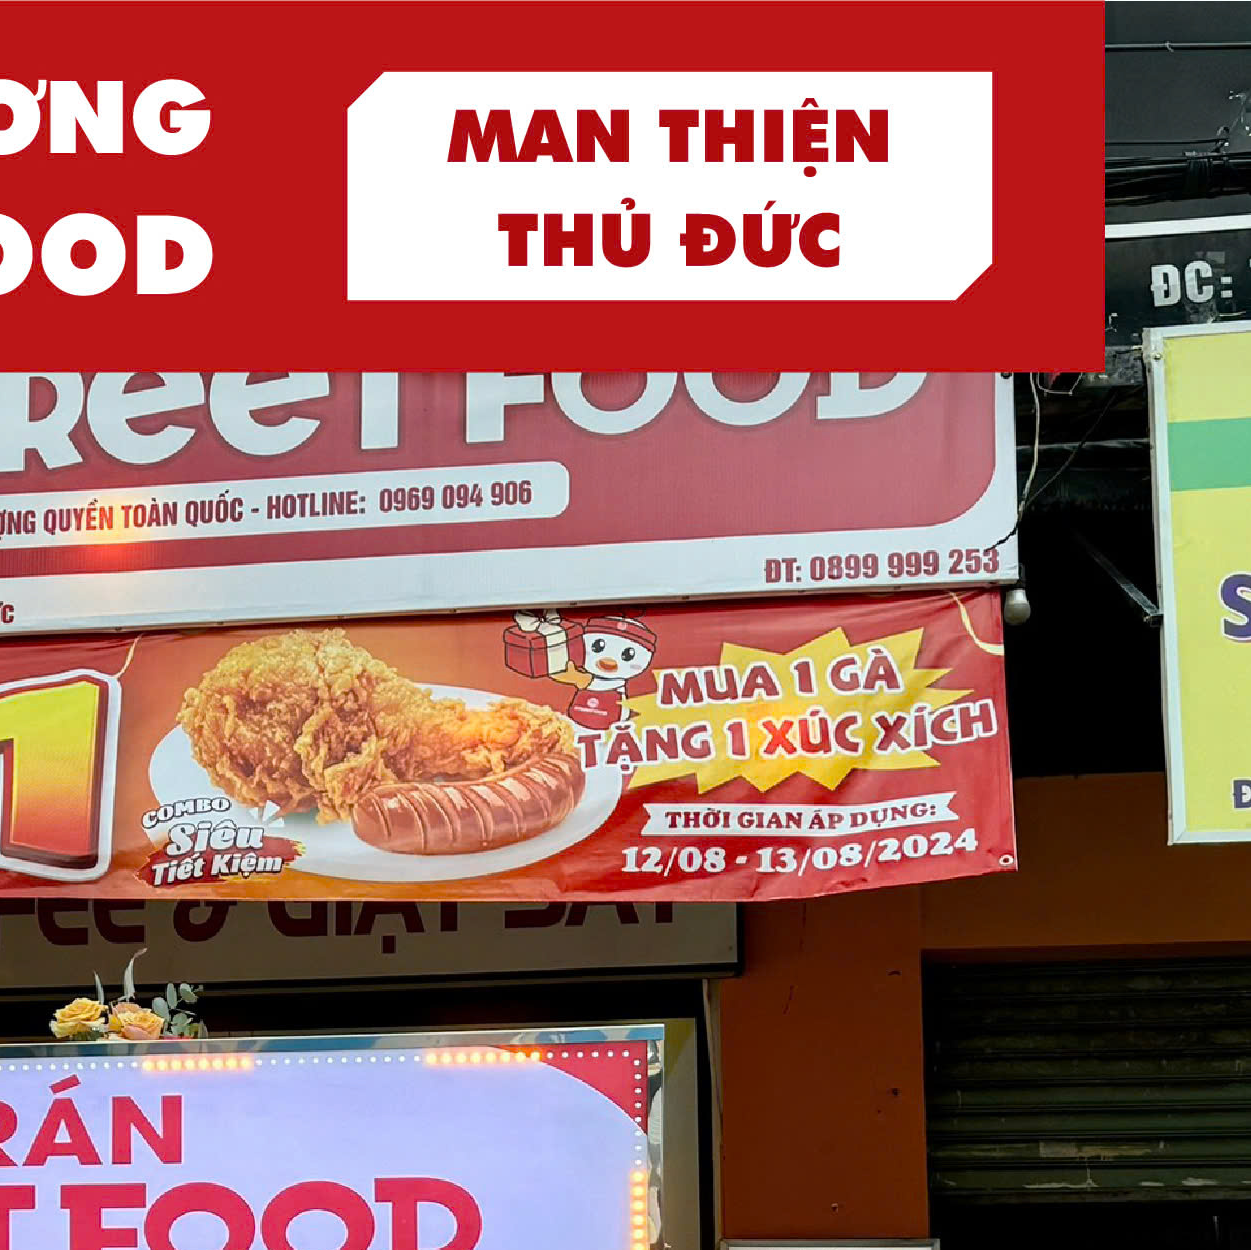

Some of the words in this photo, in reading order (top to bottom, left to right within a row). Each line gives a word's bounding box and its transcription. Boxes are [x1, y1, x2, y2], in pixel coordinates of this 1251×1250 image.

[1151, 259, 1233, 307] ĐC:
[43, 498, 114, 536] QUYỀN
[121, 497, 178, 529] TOÀN
[185, 489, 244, 527] QUỐC
[267, 490, 366, 519] HOTLINE:
[379, 487, 435, 512] 0969
[442, 484, 483, 510] 094
[491, 480, 532, 506] 906
[764, 557, 802, 584] ĐT:
[810, 553, 879, 582] 0899
[888, 549, 940, 579] 999
[949, 549, 1000, 574] 253
[656, 661, 780, 707] MUA
[789, 657, 818, 696] 1
[827, 646, 902, 694] GÀ
[576, 724, 714, 775] TẶNG
[725, 717, 751, 758] 1
[758, 708, 865, 757] XÚC
[872, 698, 999, 753] XÍCH
[142, 797, 231, 830] COMBO
[664, 806, 731, 830] THỜI
[735, 810, 802, 830] GIAN
[808, 806, 845, 830] ÁP
[849, 802, 937, 830] DỤNG:
[166, 819, 264, 856] Siêu
[621, 845, 727, 877] 12/08
[736, 853, 748, 863] -
[755, 829, 979, 877] 13/08/2024
[152, 853, 206, 886] Tiết
[211, 853, 283, 879] Kiệm
